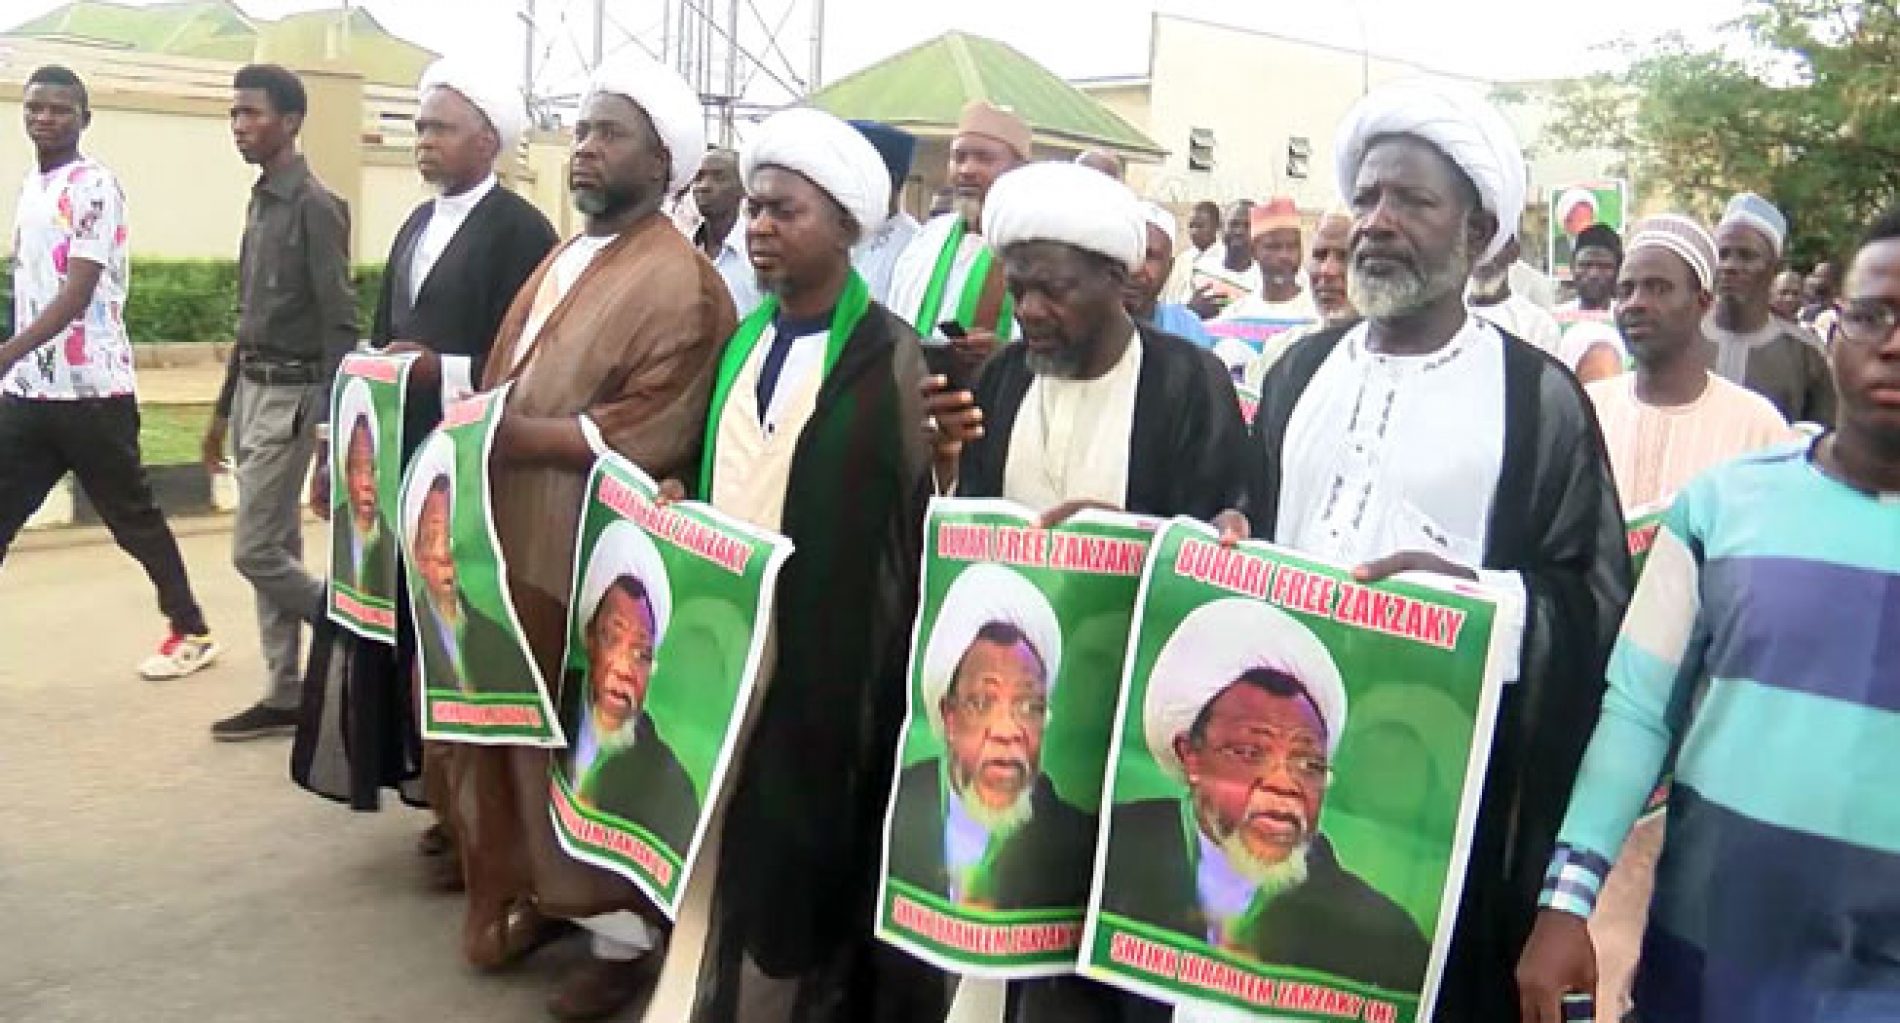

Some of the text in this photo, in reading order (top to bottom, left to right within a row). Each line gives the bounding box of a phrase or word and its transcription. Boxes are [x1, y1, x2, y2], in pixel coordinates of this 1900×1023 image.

[937, 521, 1148, 577] BUHARI FREE ZAKZAKY
[1174, 537, 1467, 652] BUHARI FREE ZAKZAKY
[1110, 932, 1178, 978] SHEIKH
[1177, 951, 1276, 1005] IBRAHEEM
[1274, 980, 1366, 1020] ZAKZAKY
